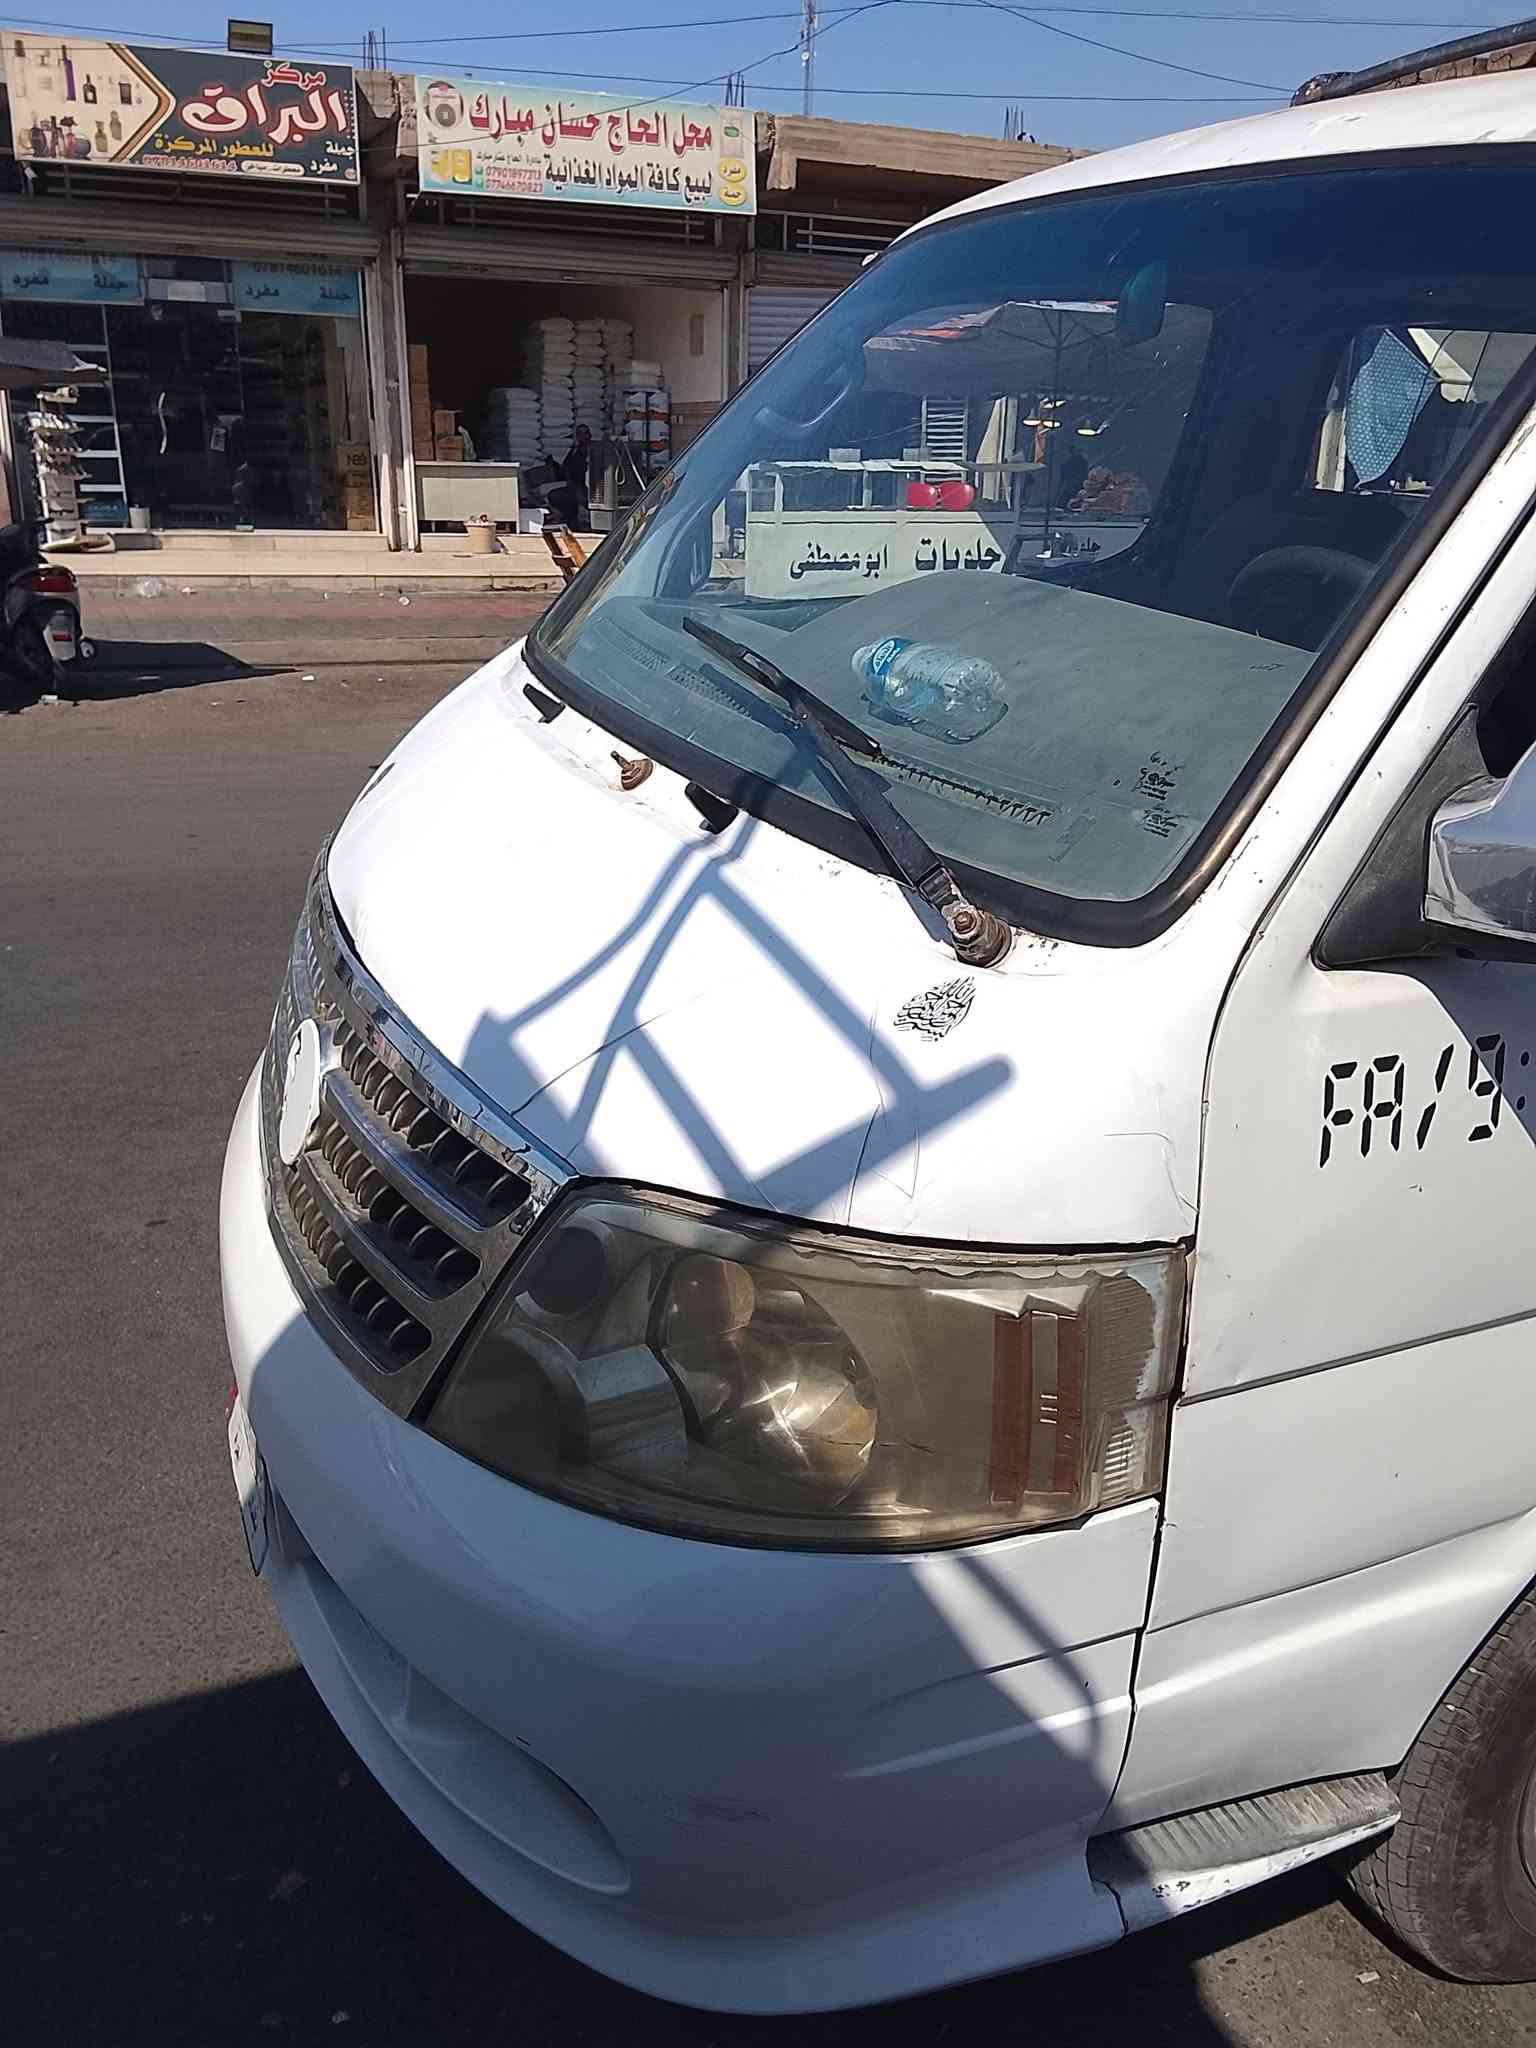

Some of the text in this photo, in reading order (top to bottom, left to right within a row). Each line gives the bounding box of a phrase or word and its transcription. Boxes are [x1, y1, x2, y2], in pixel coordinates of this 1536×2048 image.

[261, 61, 327, 92] مركز
[181, 82, 347, 145] البراق
[469, 93, 535, 146] مبارك
[608, 108, 668, 153] الحاج
[673, 113, 713, 157] محل
[154, 133, 275, 157] للعطور المركزة
[310, 158, 338, 174] مفرد
[325, 141, 355, 160] جملة
[545, 154, 713, 204] لبيع كافة المواد الغذائية
